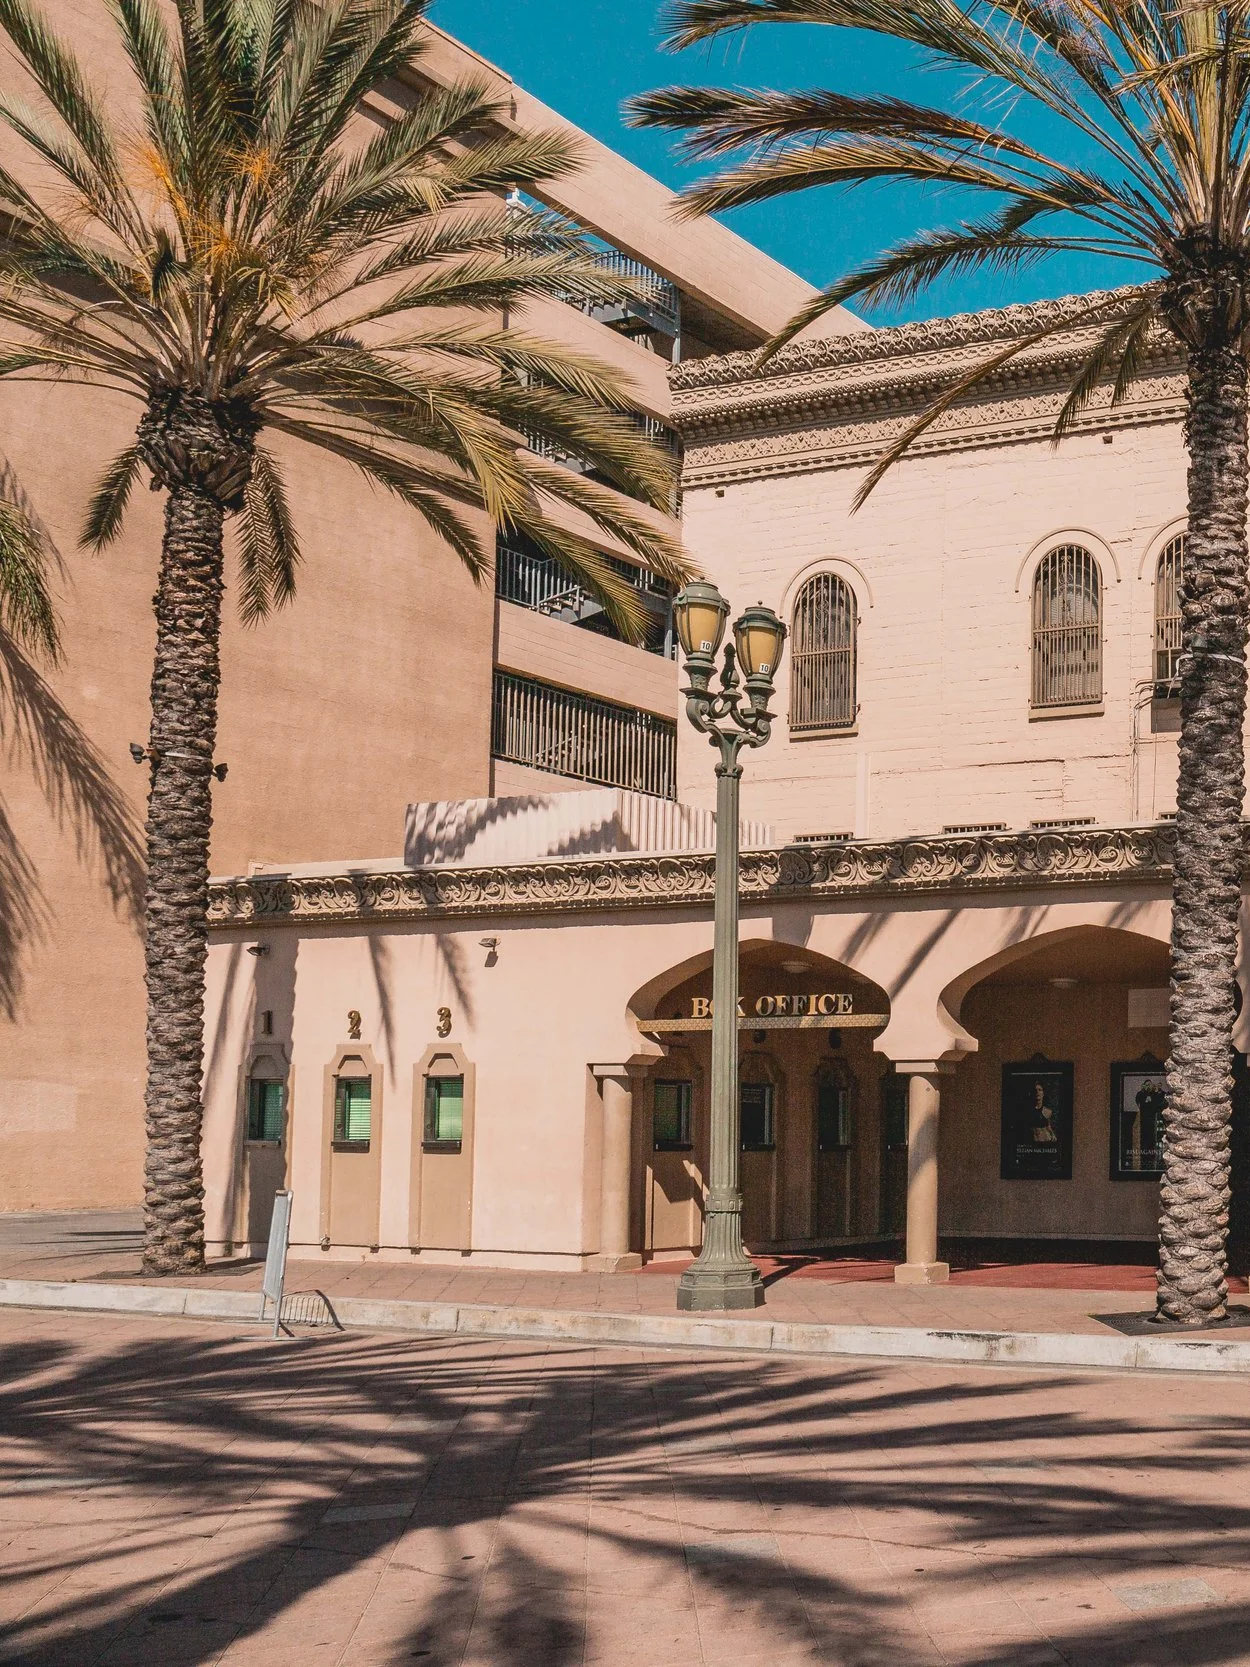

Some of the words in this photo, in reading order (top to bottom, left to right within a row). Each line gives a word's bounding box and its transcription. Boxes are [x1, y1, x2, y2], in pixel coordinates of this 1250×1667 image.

[702, 642, 711, 650] 10
[761, 664, 769, 672] 10
[755, 994, 853, 1015] OFFICE
[261, 1010, 273, 1034] 1
[347, 1010, 361, 1036] 2
[436, 1007, 452, 1035] 3
